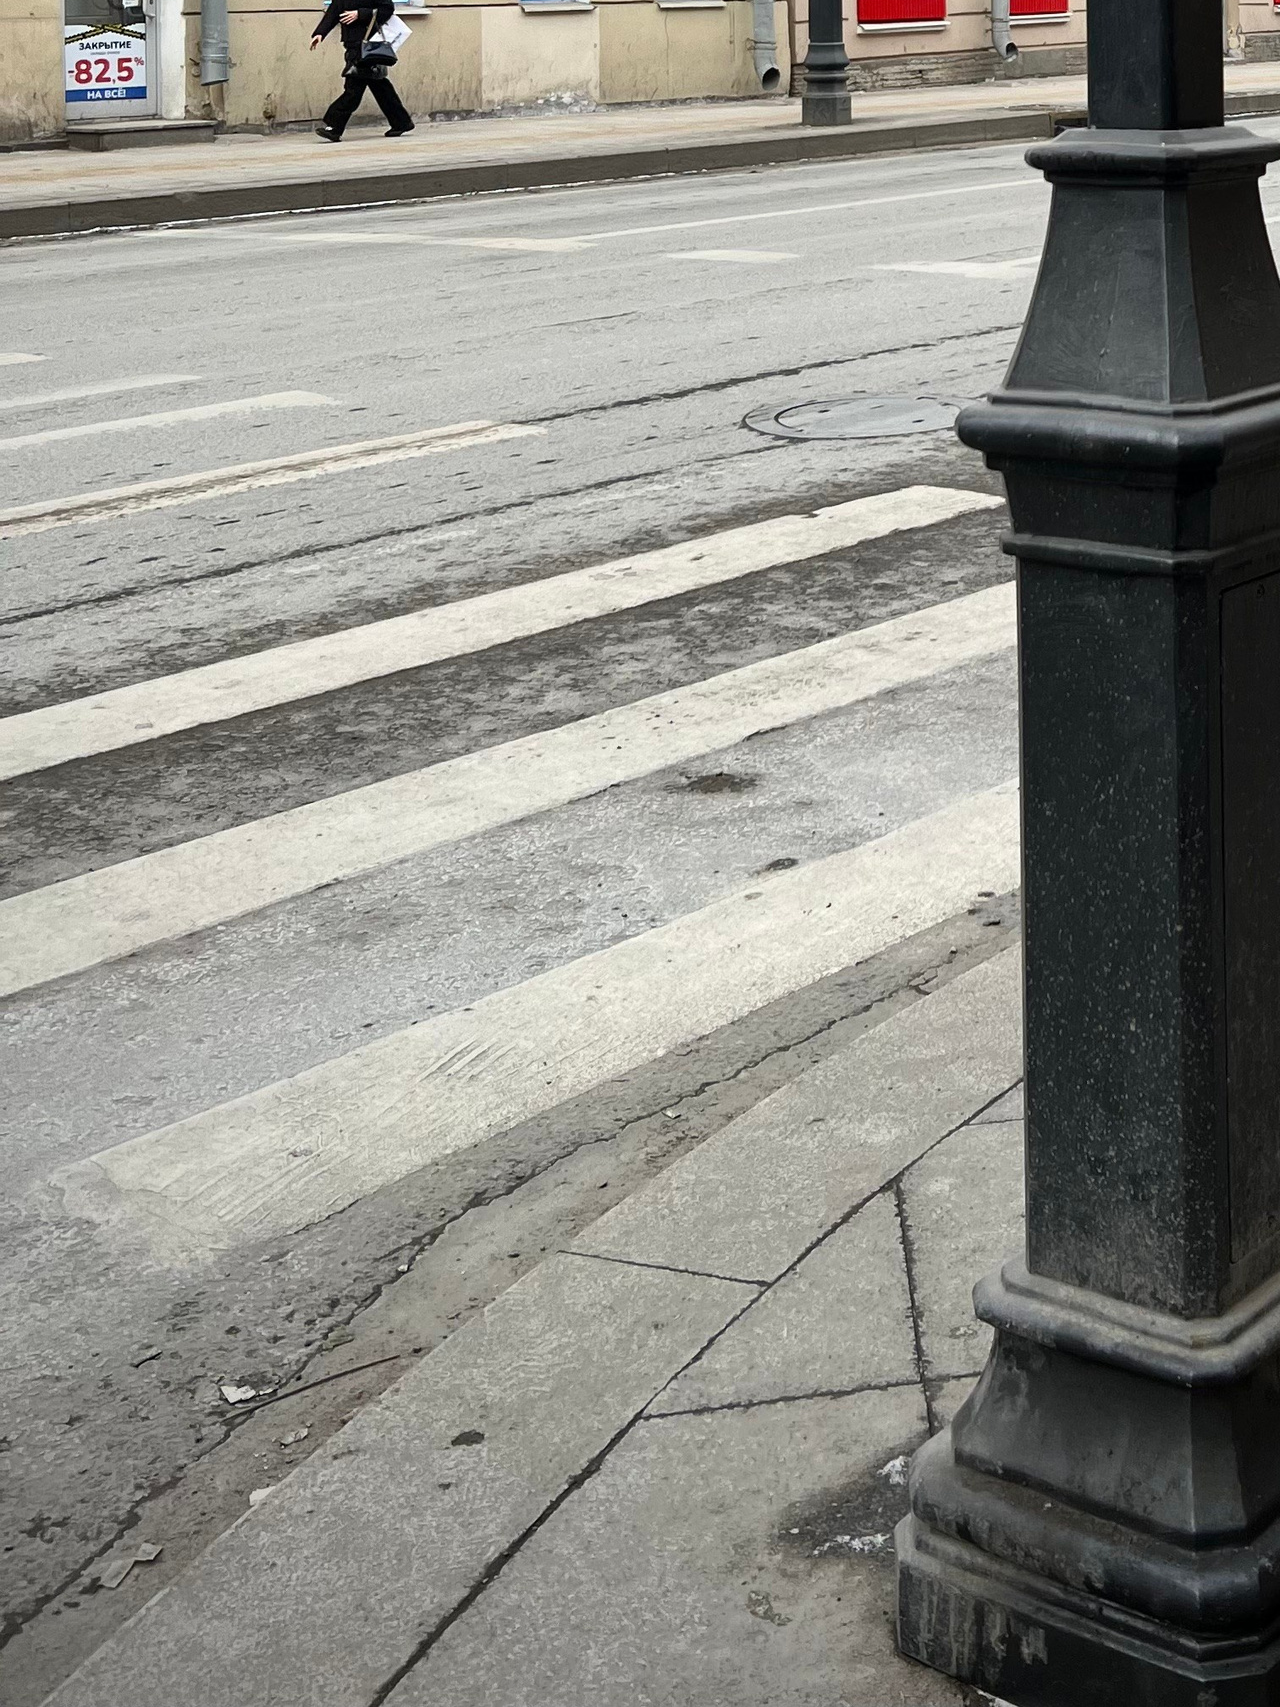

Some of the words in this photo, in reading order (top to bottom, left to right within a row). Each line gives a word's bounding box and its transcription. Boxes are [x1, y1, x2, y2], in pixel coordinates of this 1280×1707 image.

[79, 41, 132, 51] ЗАКРЫТИЕ
[68, 57, 144, 84] -82,5%
[87, 90, 101, 100] НА
[104, 87, 126, 98] ВСЁ!
